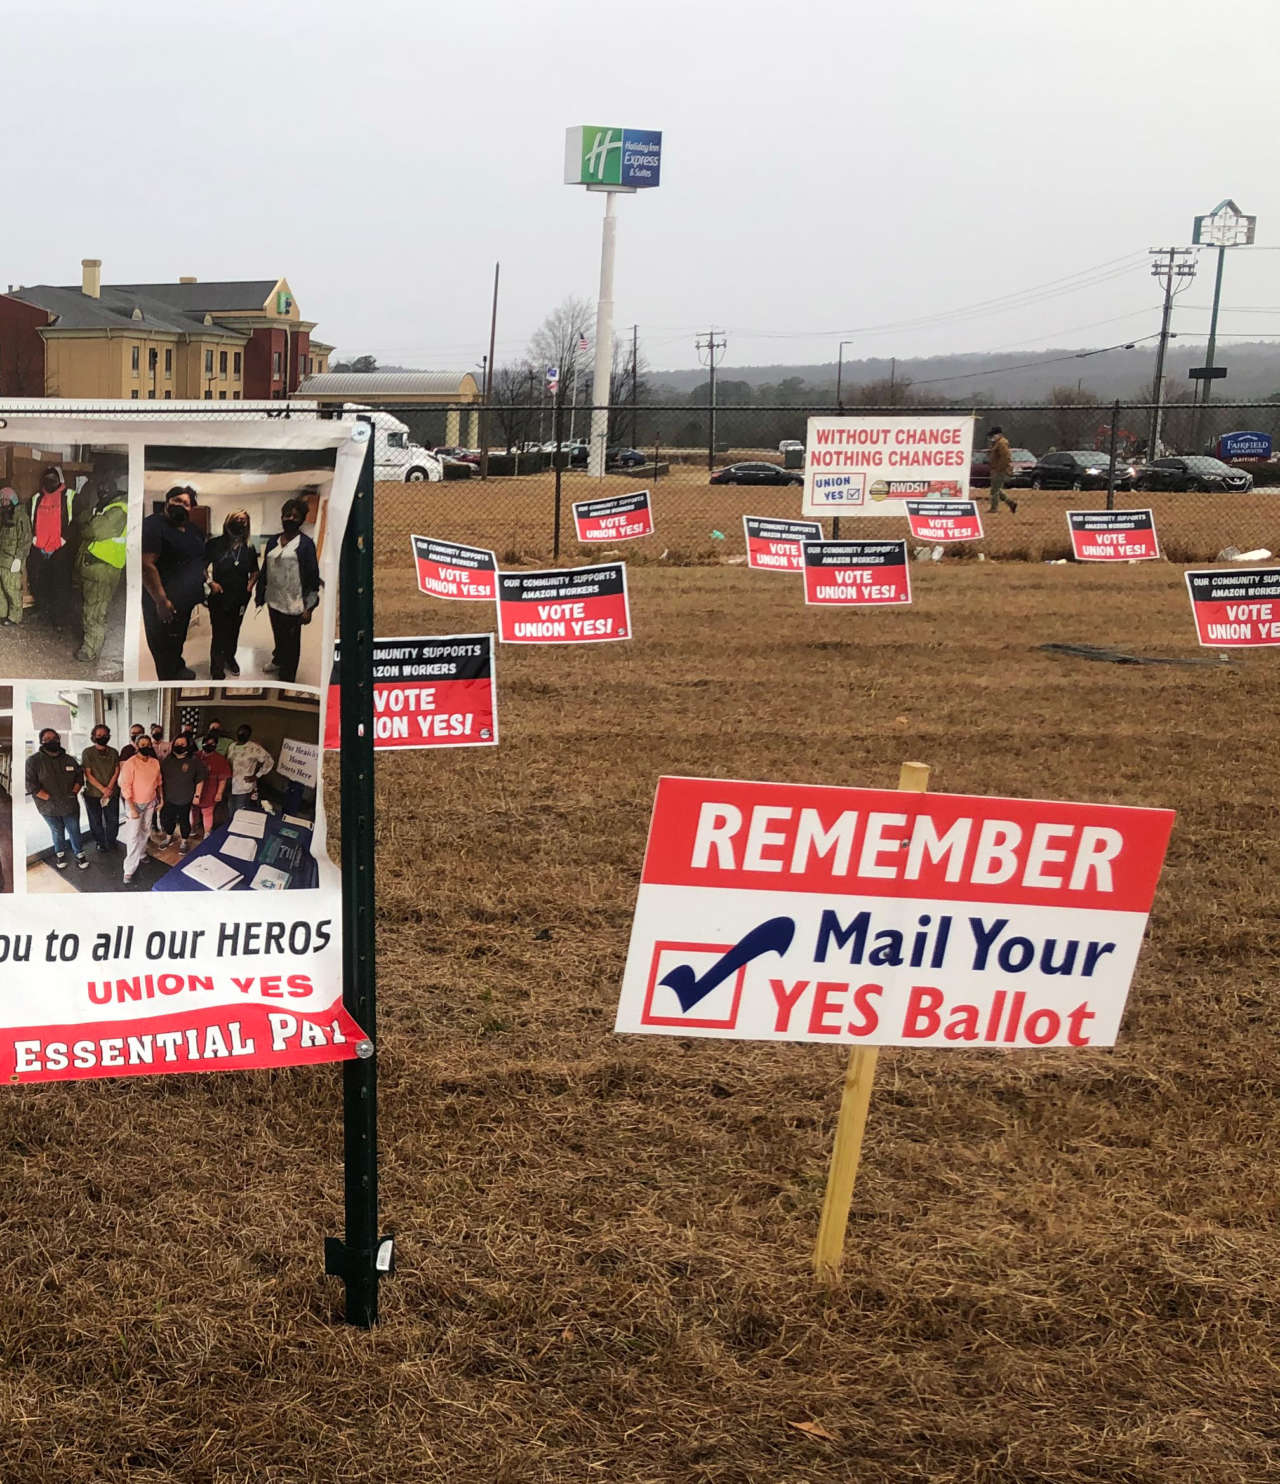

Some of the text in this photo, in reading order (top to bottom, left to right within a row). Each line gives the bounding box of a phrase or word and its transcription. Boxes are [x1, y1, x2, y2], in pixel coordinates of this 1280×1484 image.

[650, 142, 659, 152] Inn
[624, 152, 659, 168] Express
[816, 428, 962, 444] WITHOUT CHANGE
[1227, 440, 1268, 449] FAIRFIELD
[810, 450, 964, 466] NOTHING CHANGES
[816, 476, 850, 488] UNION
[890, 482, 928, 493] RWDSU
[824, 490, 844, 500] YES
[600, 516, 627, 528] VOTE
[619, 522, 644, 536] YES!
[928, 518, 955, 528] VOTE
[947, 528, 972, 537] YES!
[1096, 534, 1126, 544] VOTE
[769, 543, 799, 556] VOTE
[1082, 544, 1146, 556] UNION YES!
[756, 554, 788, 567] UNION
[438, 567, 470, 583] VOTE
[504, 571, 617, 588] OUR COMMUNITY SUPPORTS
[834, 570, 872, 584] VOTE
[1194, 578, 1209, 586] OUR
[1212, 576, 1260, 586] COMMUNITY
[425, 576, 491, 596] UNION YES!
[522, 585, 600, 599] AMAZON WORKERS
[816, 585, 896, 599] UNION YES!
[1212, 588, 1246, 598] AMAZON
[538, 603, 585, 620] VOTE
[1226, 604, 1272, 620] VOTE
[514, 618, 613, 638] UNION YES!
[1208, 624, 1251, 640] UNION
[422, 645, 481, 658] SUPPORTS
[402, 663, 456, 676] WORKERS
[373, 688, 436, 712] VOTE
[417, 713, 474, 738] YES!
[691, 802, 1124, 893] REMEMBER
[45, 930, 80, 962] to
[92, 925, 134, 962] all
[144, 930, 206, 960] our
[216, 918, 332, 957] HEROS
[813, 909, 1116, 978] Mail Your
[88, 974, 314, 1005] UNION YES
[769, 979, 1097, 1047] YES Ballot
[14, 1020, 256, 1074] ESSENTIAL
